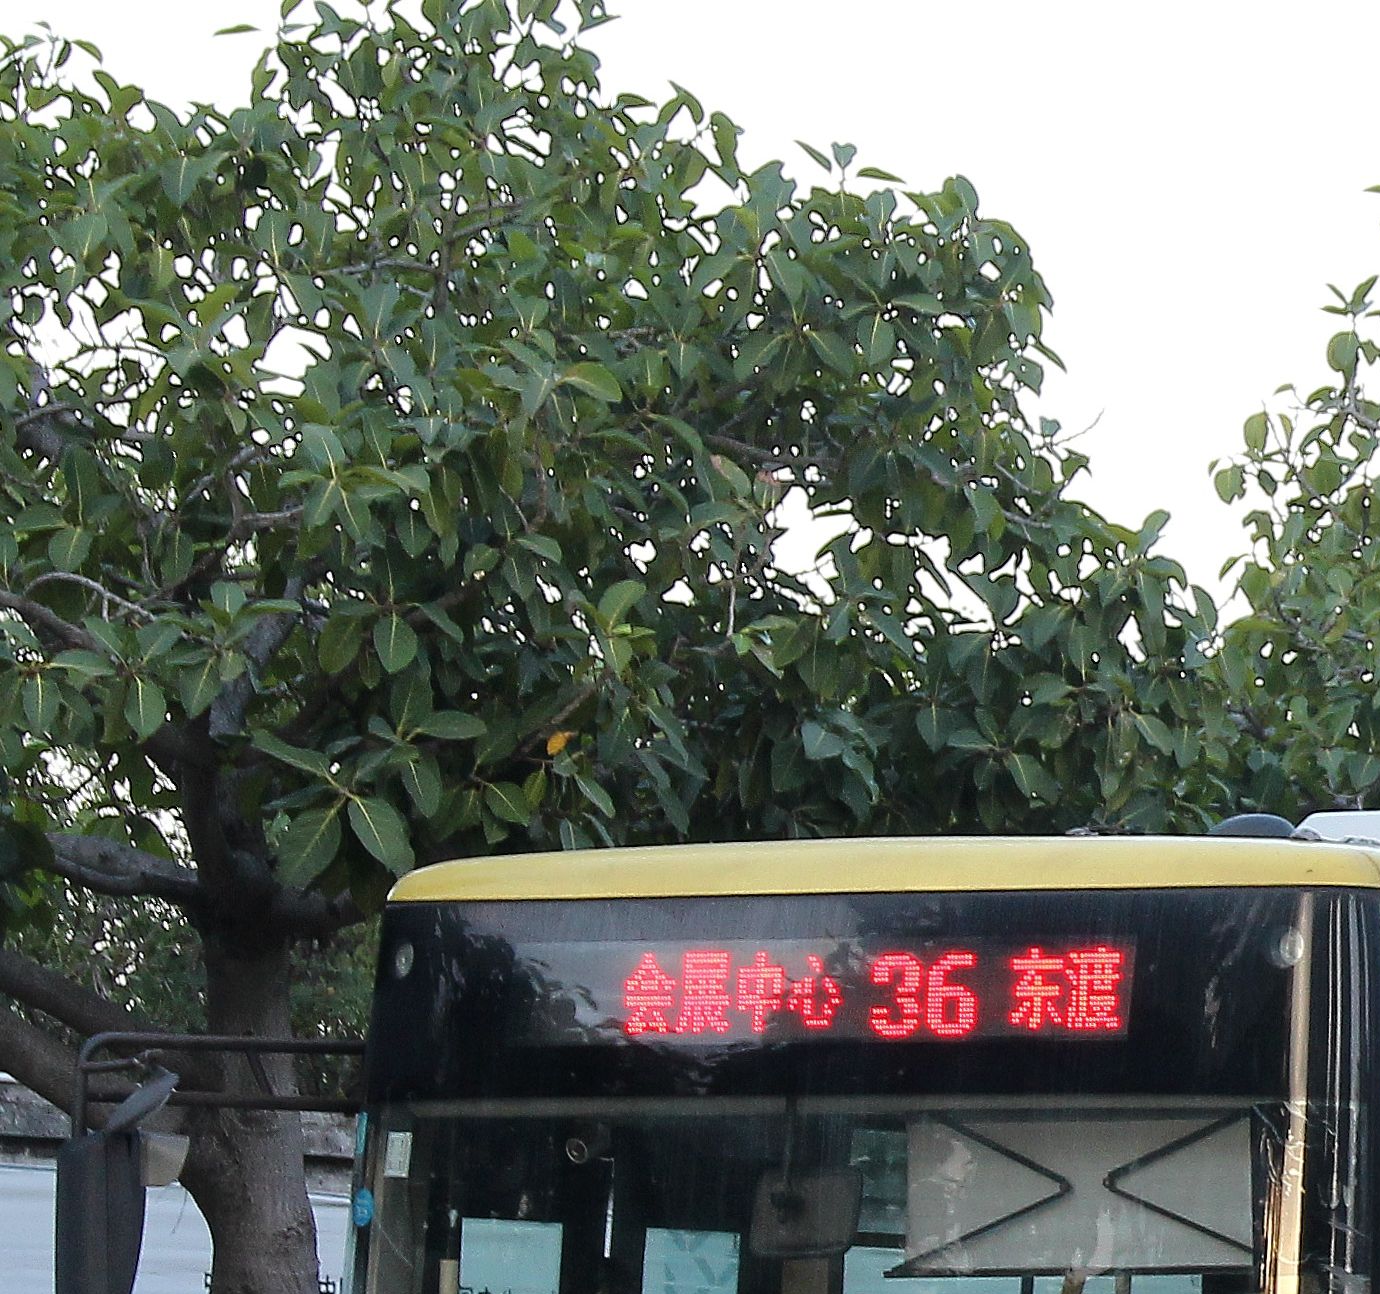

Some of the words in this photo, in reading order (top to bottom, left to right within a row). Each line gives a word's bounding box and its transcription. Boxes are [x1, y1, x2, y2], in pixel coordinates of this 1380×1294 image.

[624, 951, 844, 1034] 会展中心
[868, 951, 978, 1038] 36
[1008, 944, 1126, 1032] 东渡
